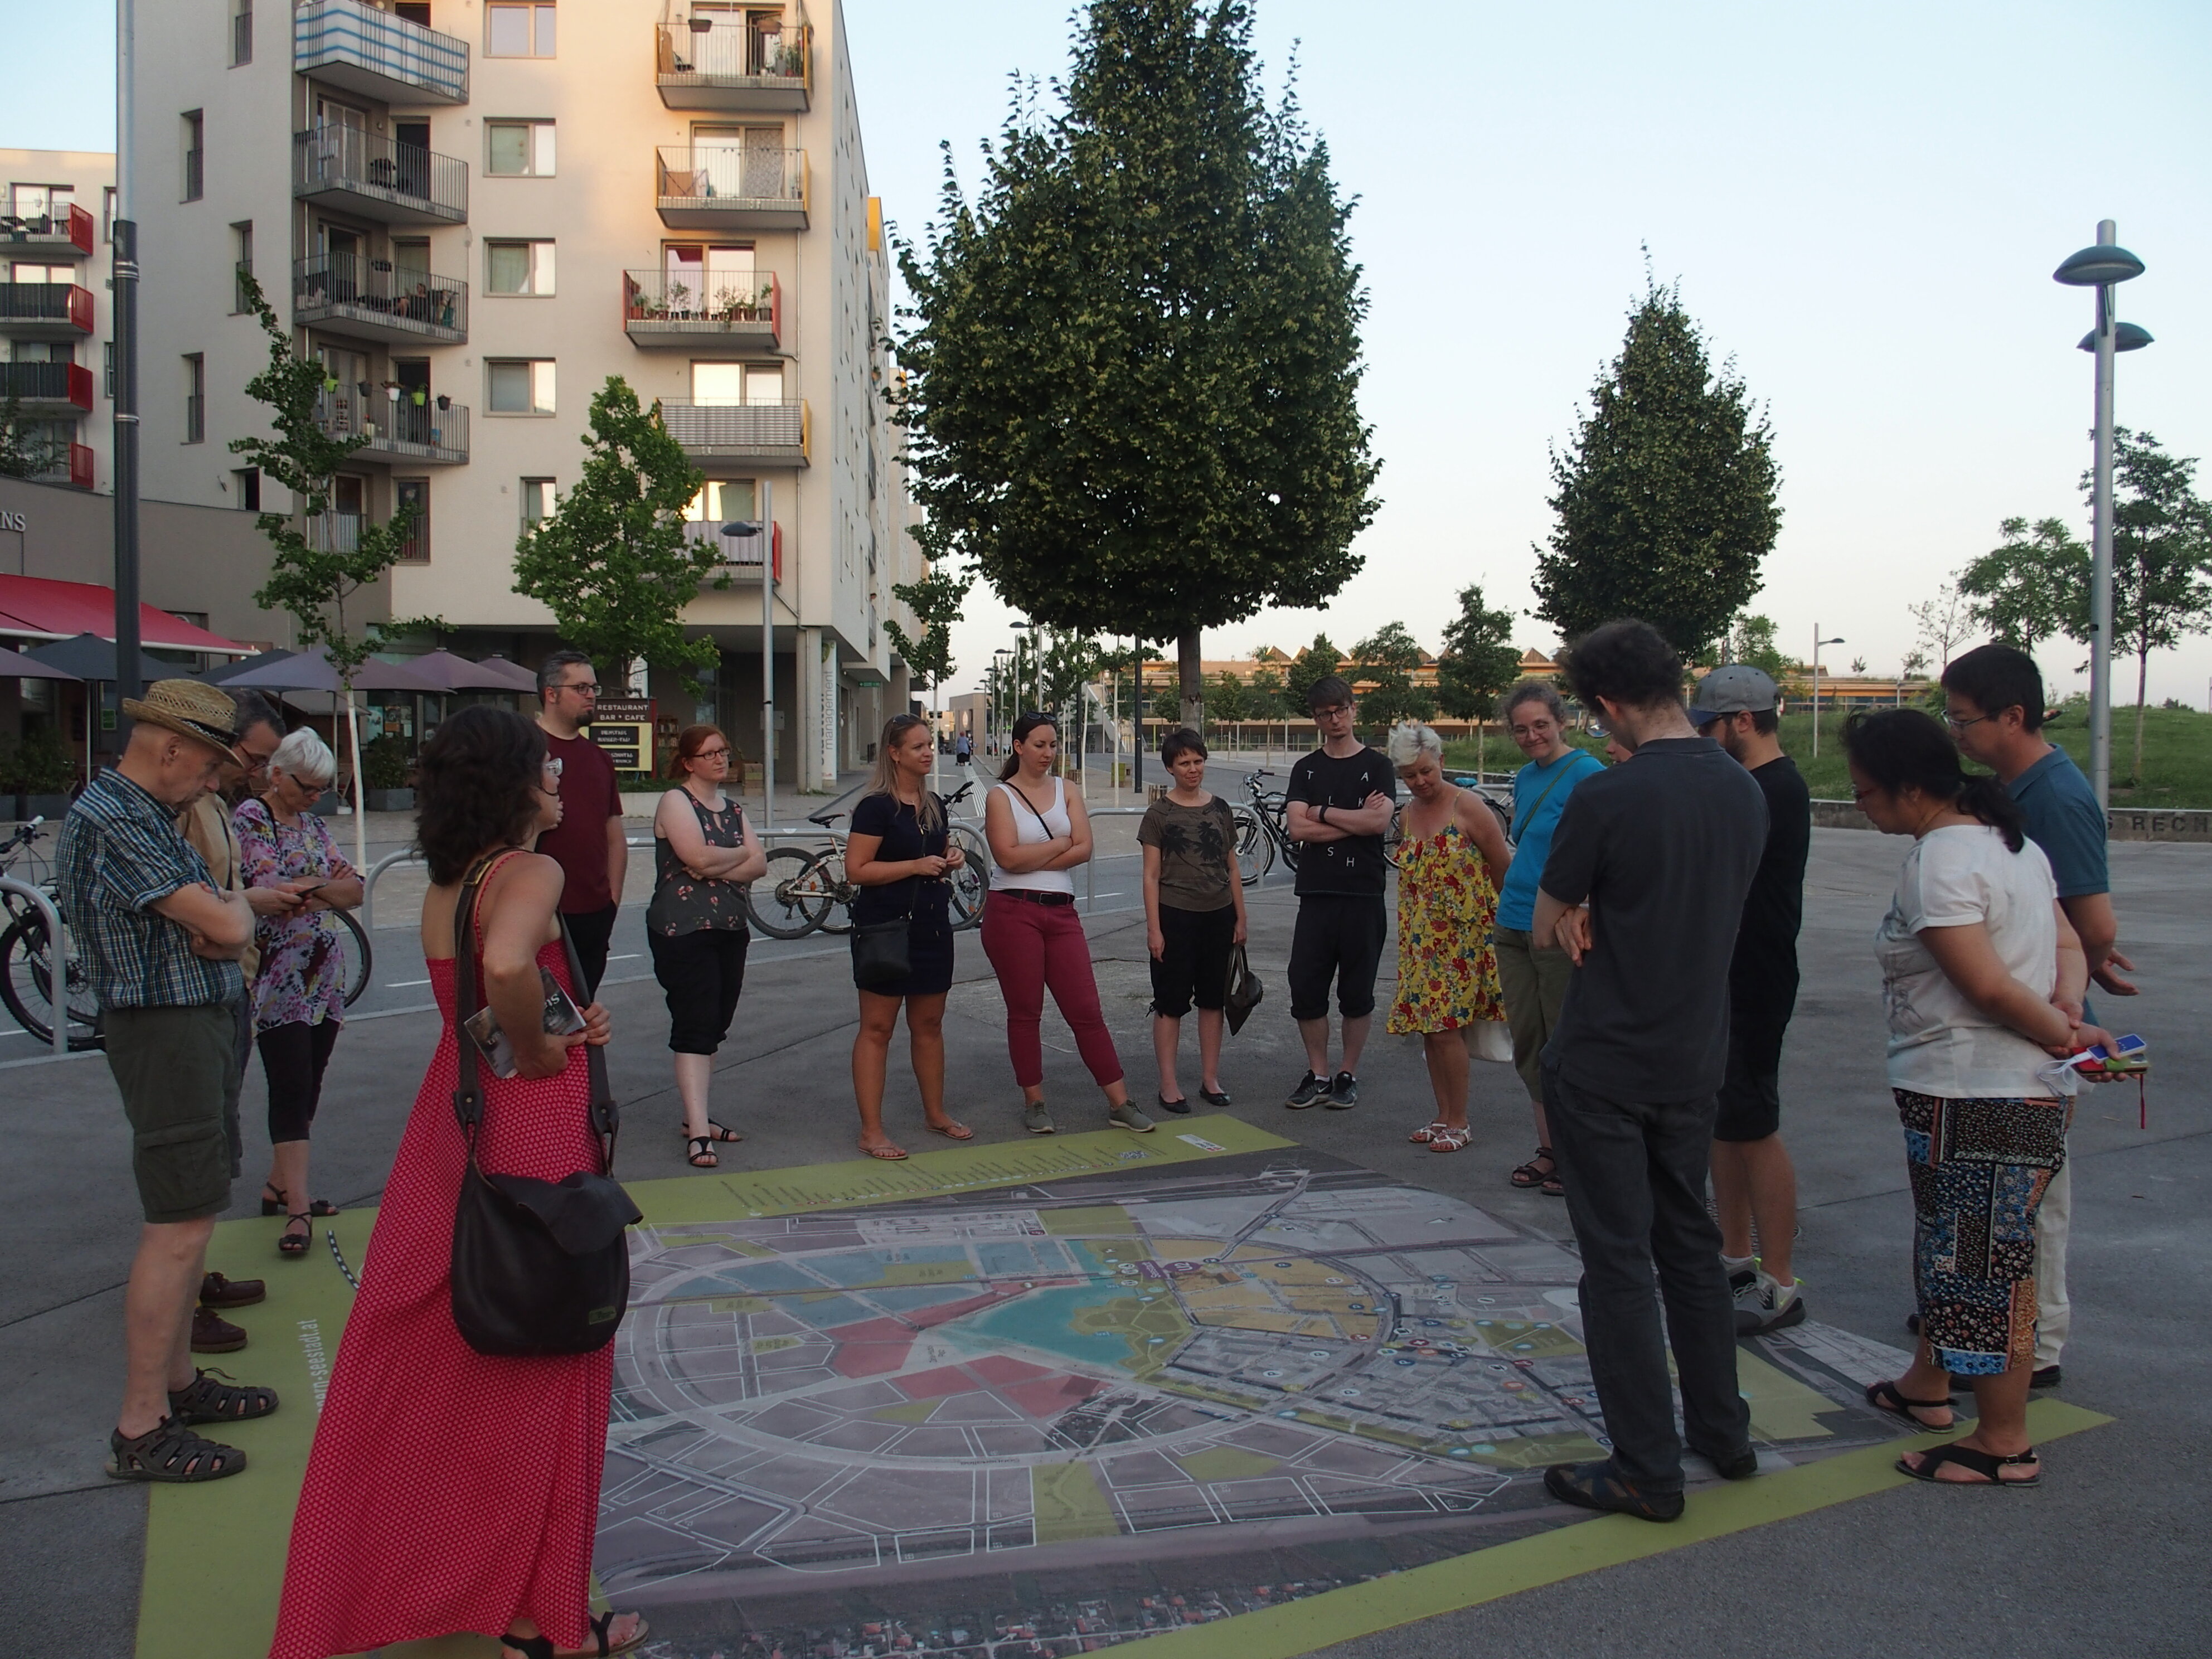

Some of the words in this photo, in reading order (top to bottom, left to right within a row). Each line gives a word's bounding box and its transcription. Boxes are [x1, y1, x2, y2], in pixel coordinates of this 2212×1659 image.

[824, 671, 835, 750] management
[2132, 816, 2208, 832] RECH
[297, 1319, 329, 1413] ern-seestadt.at
